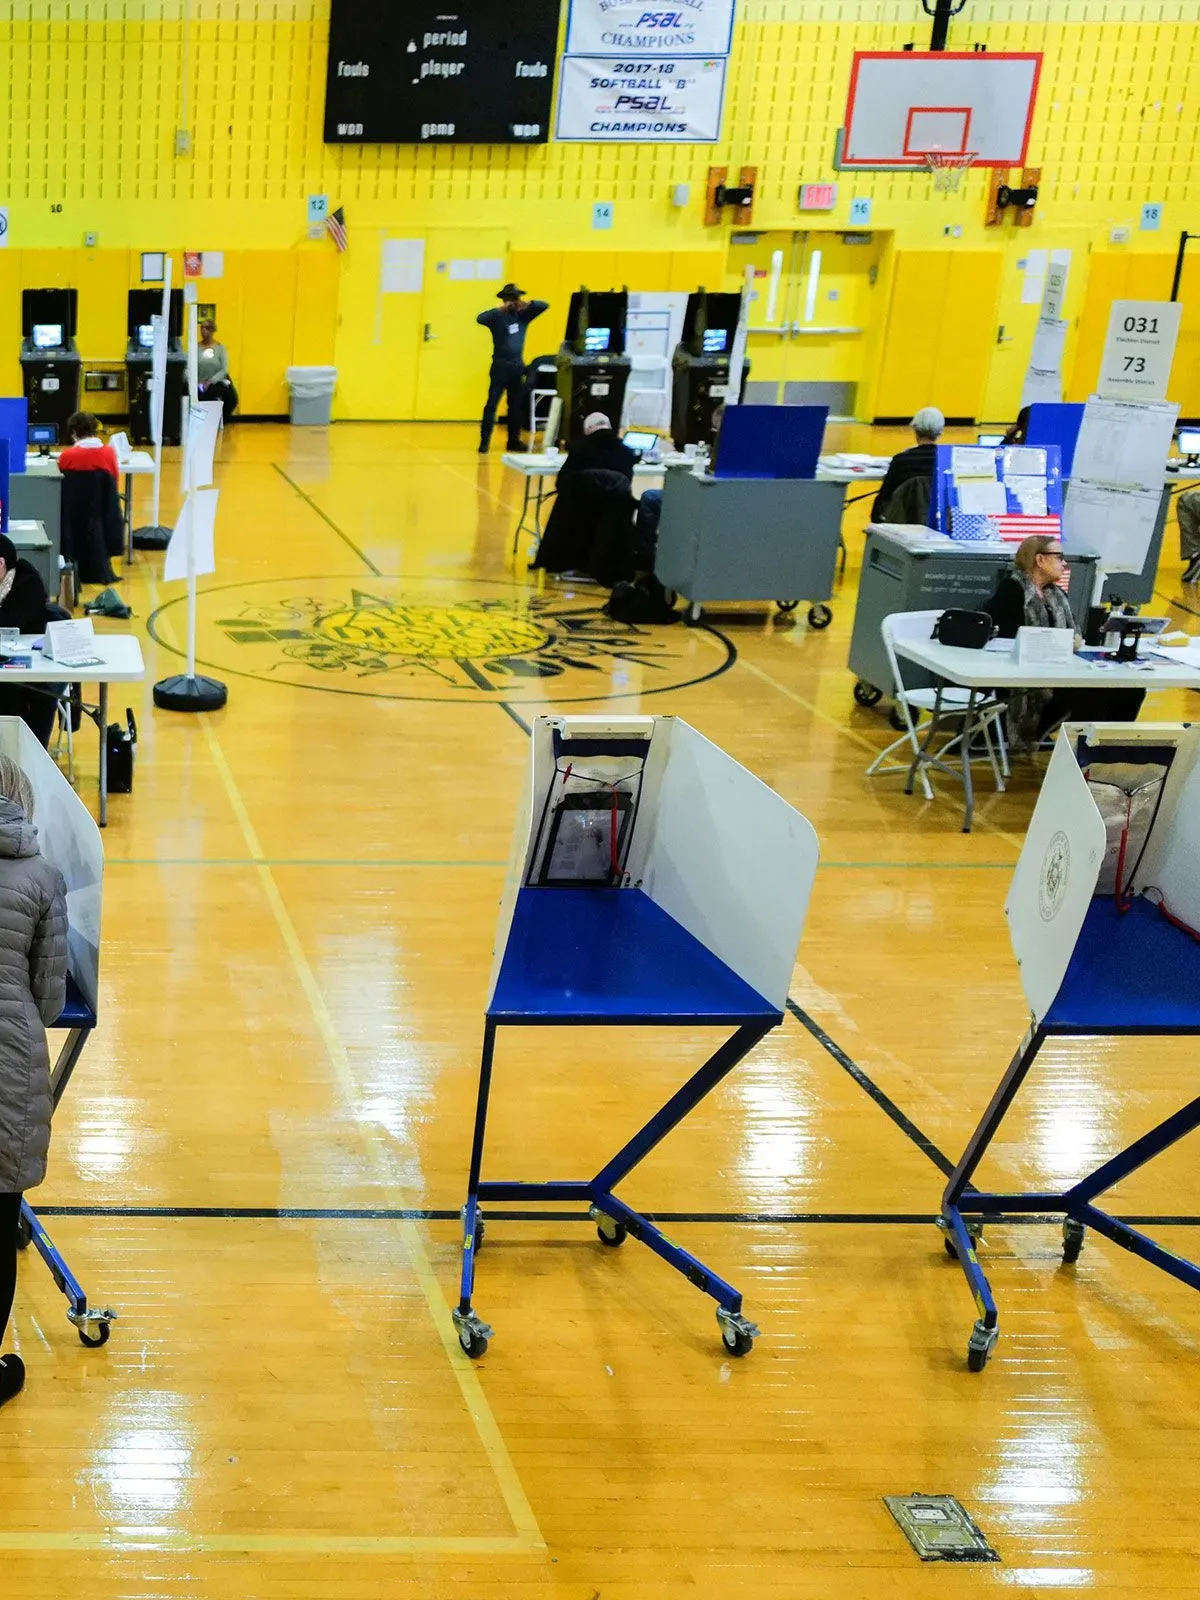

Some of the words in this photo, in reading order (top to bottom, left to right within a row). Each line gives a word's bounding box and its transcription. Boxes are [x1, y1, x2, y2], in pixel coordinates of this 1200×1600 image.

[423, 30, 468, 48] period
[601, 32, 696, 48] CHAMPIONS
[337, 61, 370, 77] fouls
[420, 60, 465, 78] player
[515, 61, 548, 77] fouls
[613, 64, 675, 73] 2017-18
[590, 78, 662, 88] SOFTBALL
[337, 123, 364, 135] won
[421, 122, 456, 139] game
[513, 123, 540, 136] won
[590, 122, 688, 133] CHAMPIONS
[804, 186, 833, 206] EXIT
[311, 199, 325, 210] 12
[1145, 208, 1158, 219] 18
[1123, 316, 1159, 334] 031
[1123, 356, 1146, 373] 73
